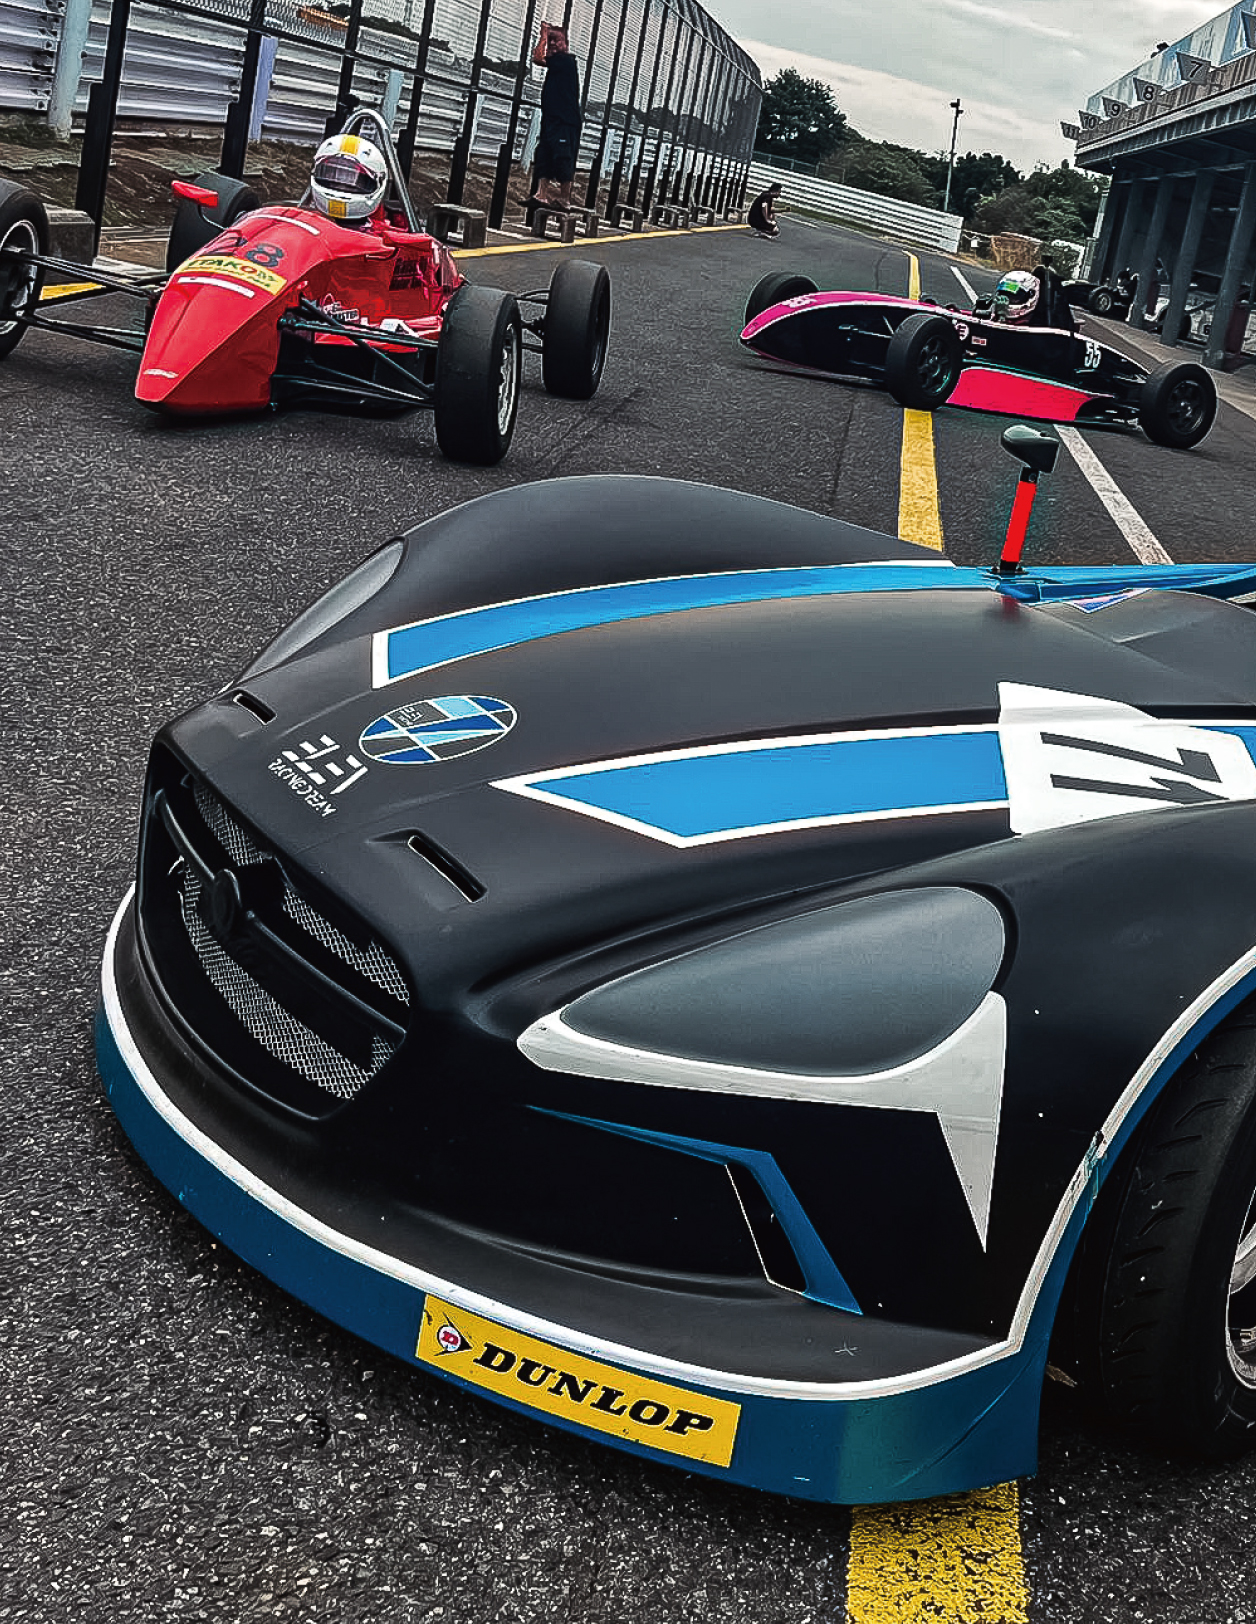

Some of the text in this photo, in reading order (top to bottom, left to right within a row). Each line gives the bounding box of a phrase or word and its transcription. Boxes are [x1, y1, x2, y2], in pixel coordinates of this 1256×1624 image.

[1189, 60, 1203, 78] 7
[1143, 85, 1155, 101] 8
[1110, 103, 1121, 117] 9
[1084, 114, 1097, 130] 10
[472, 1341, 715, 1436] DUNLOP
